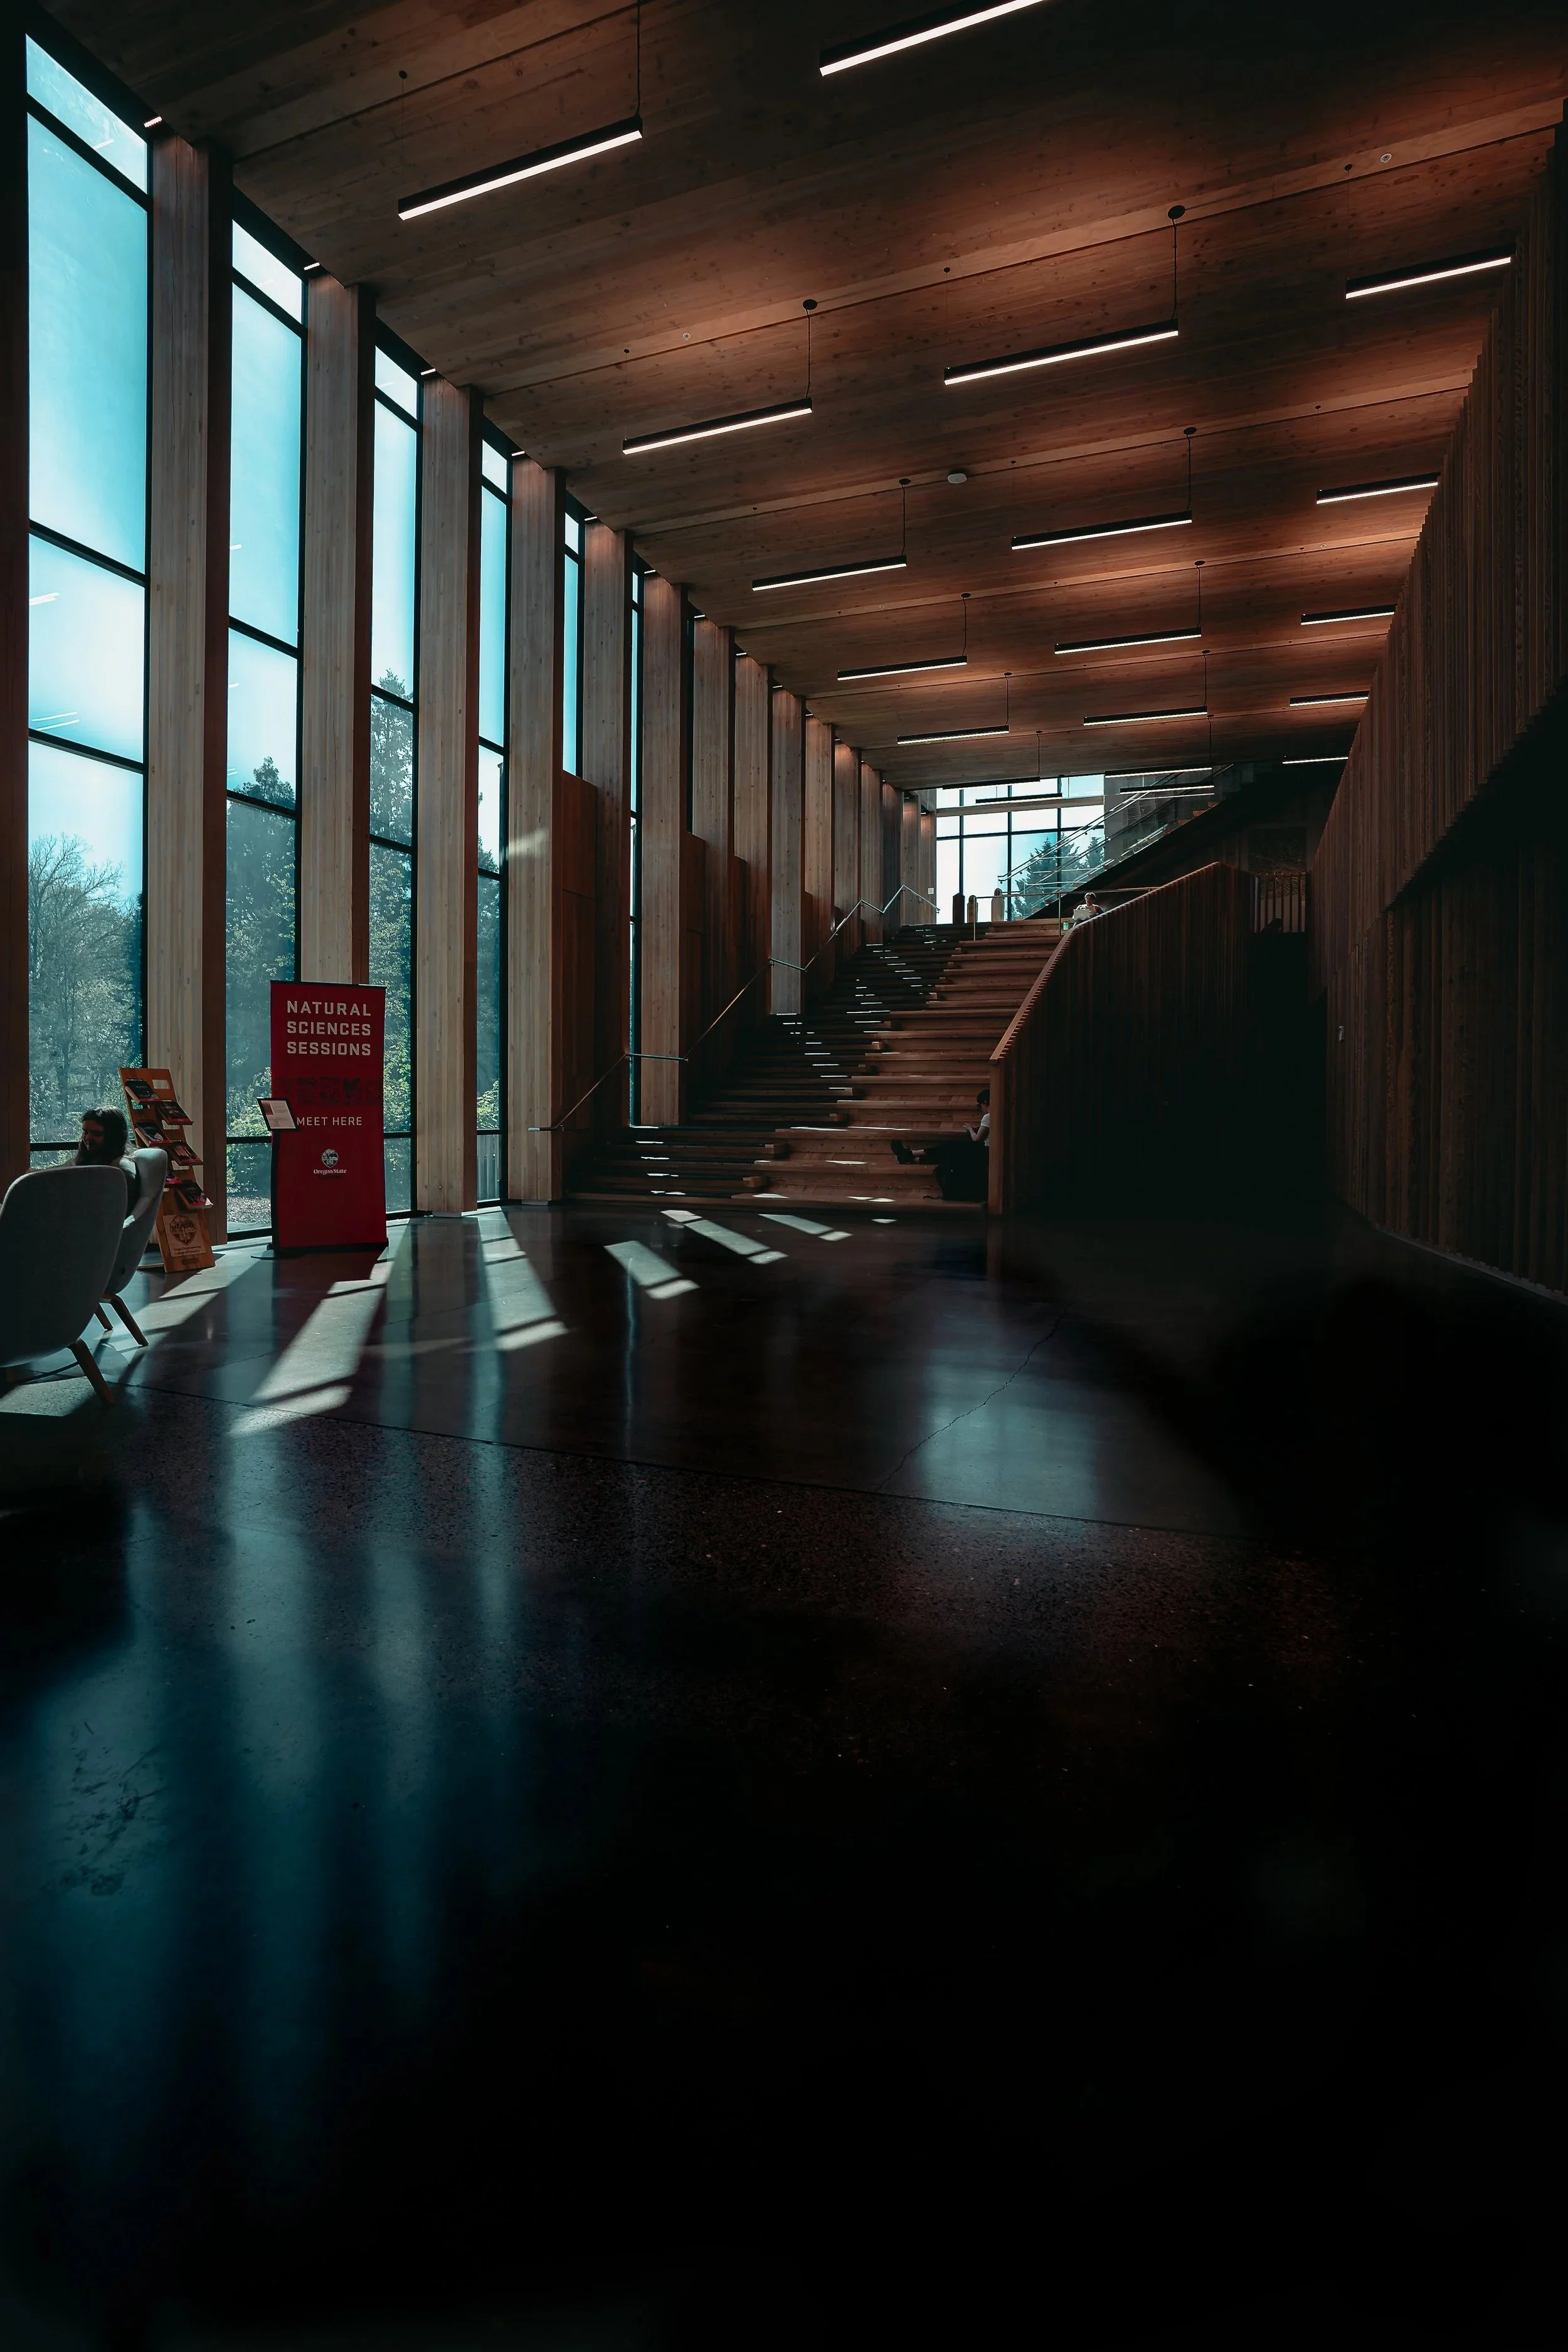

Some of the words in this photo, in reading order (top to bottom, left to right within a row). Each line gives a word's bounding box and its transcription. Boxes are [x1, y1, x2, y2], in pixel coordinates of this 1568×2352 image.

[287, 1000, 371, 1016] NATURAL
[287, 1020, 371, 1036] SCIENCES
[287, 1041, 371, 1056] SESSIONS
[297, 1116, 328, 1126] MEET
[332, 1116, 363, 1126] HERE
